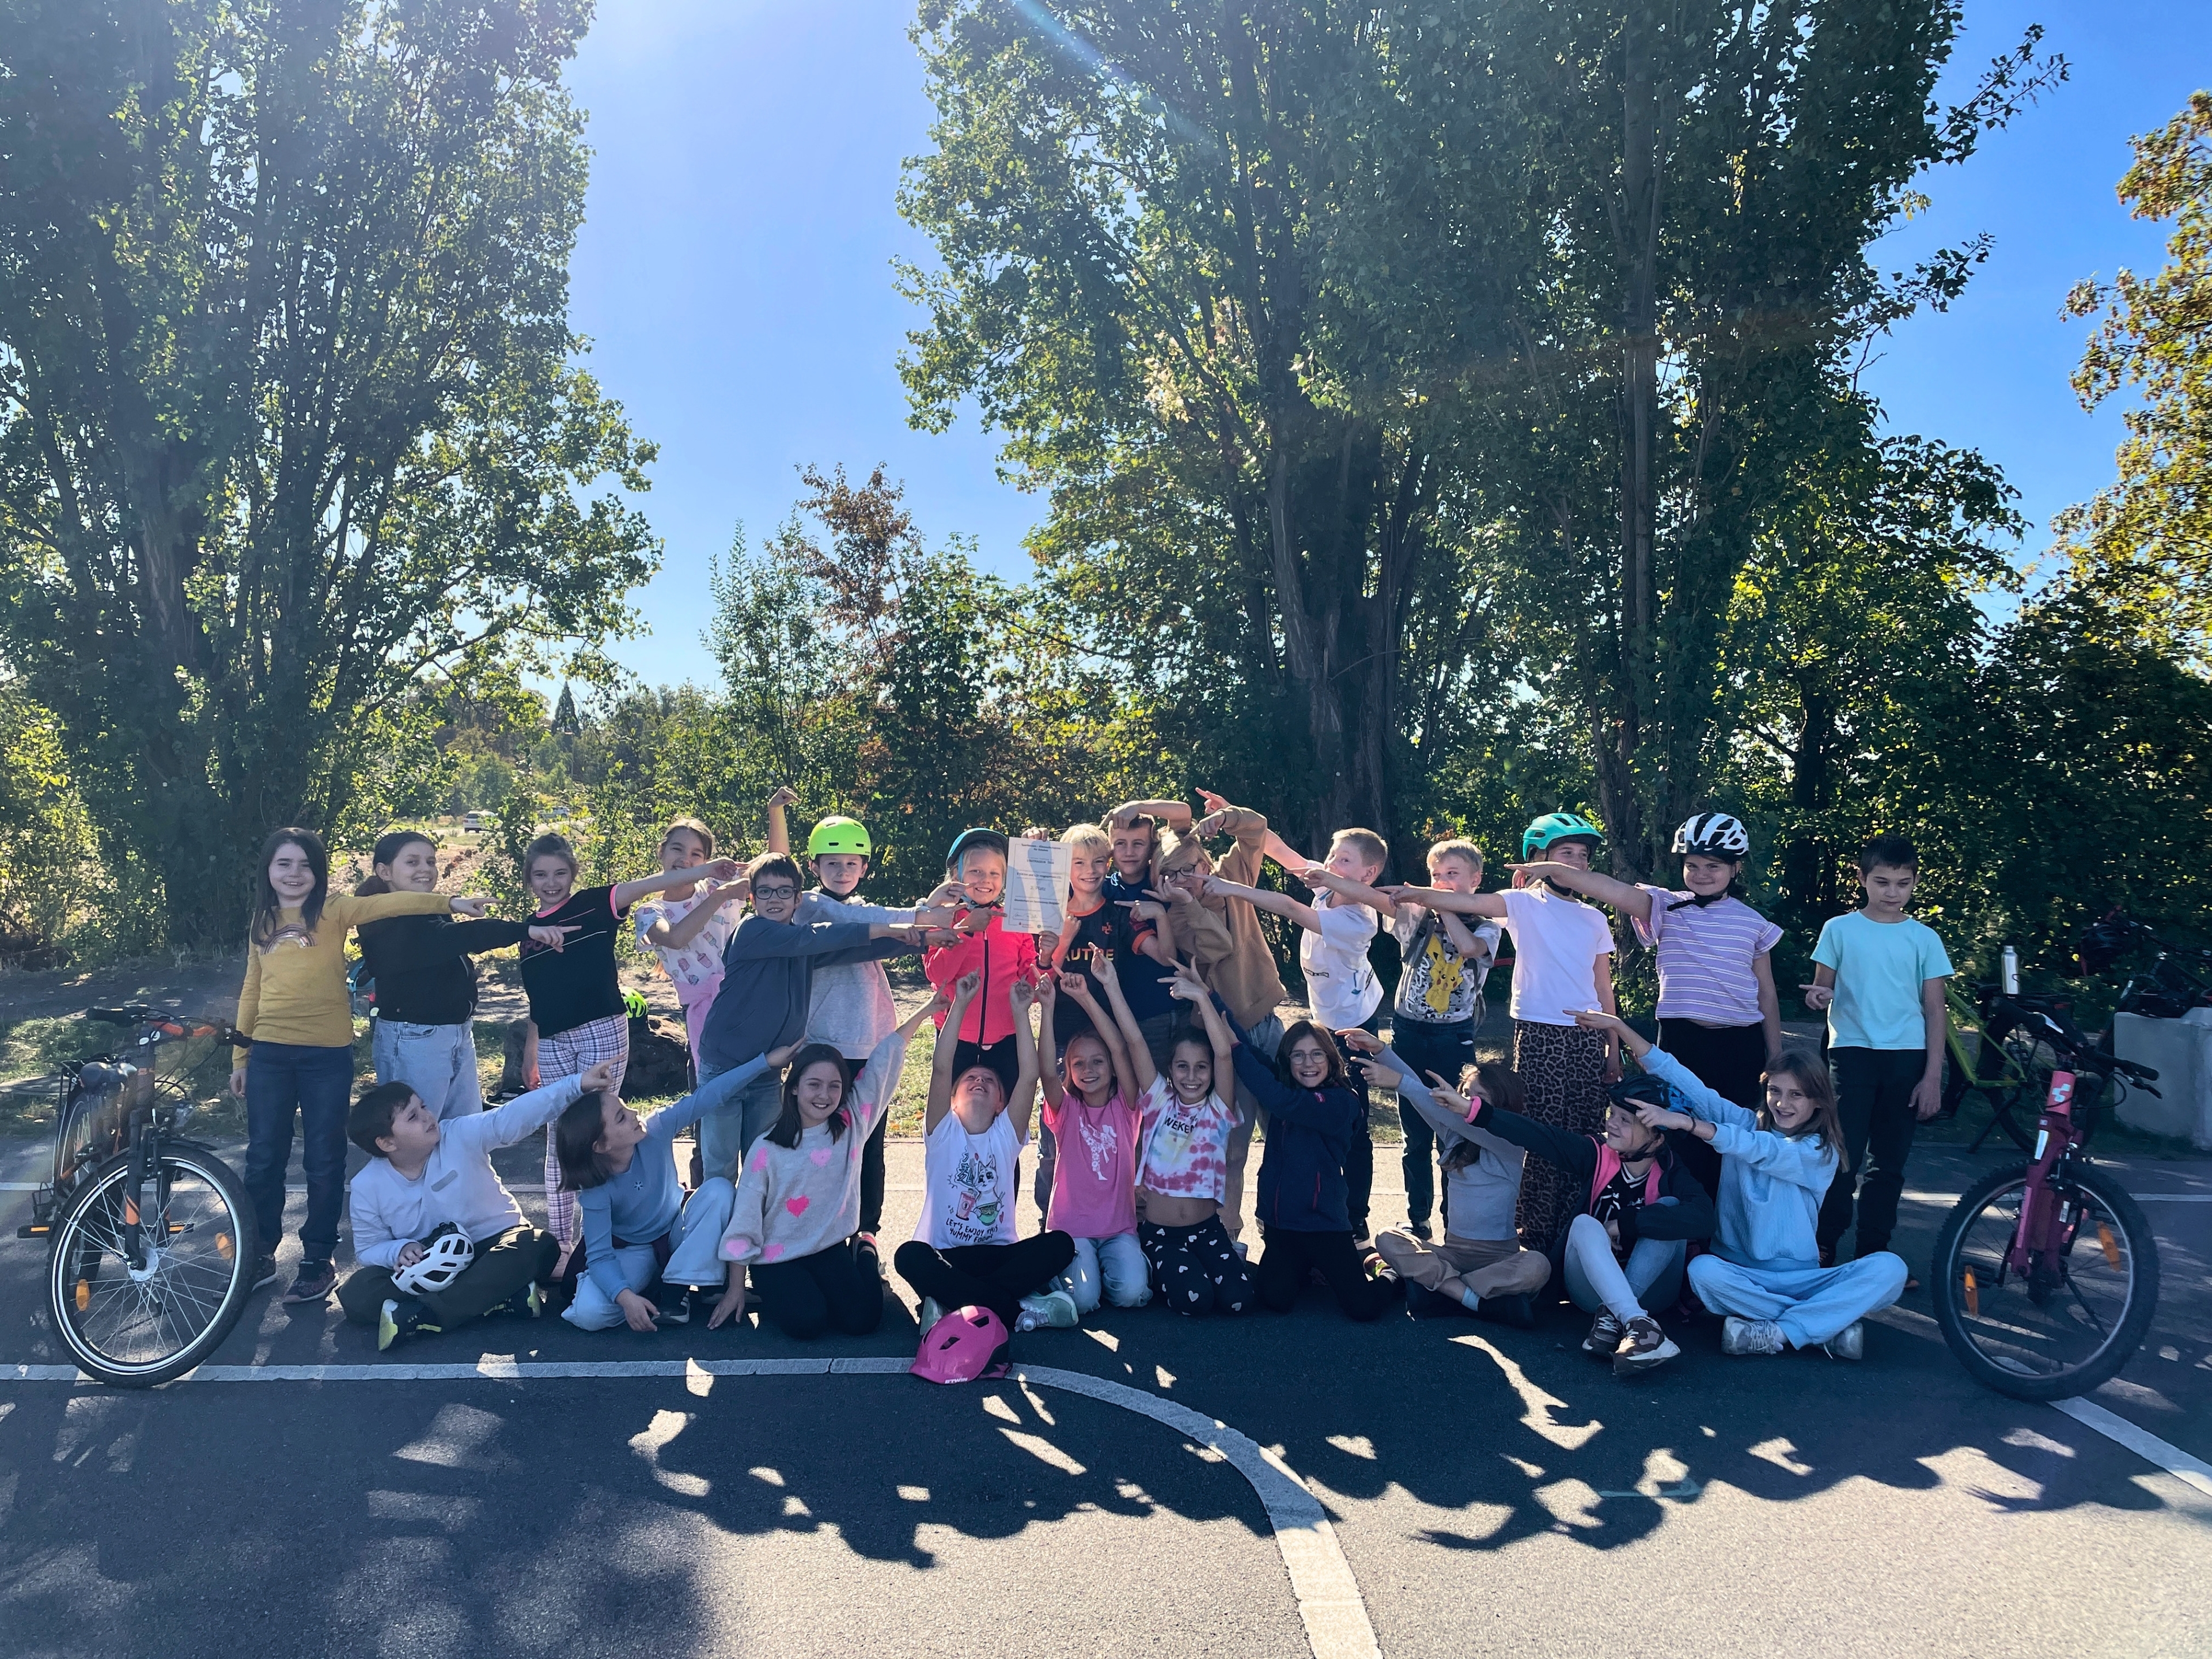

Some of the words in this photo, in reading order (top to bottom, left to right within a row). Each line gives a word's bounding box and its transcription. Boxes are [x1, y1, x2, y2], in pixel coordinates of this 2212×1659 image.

[946, 1217, 963, 1230] LET'S
[965, 1225, 984, 1236] ENJOY
[950, 1228, 972, 1241] YUMMY
